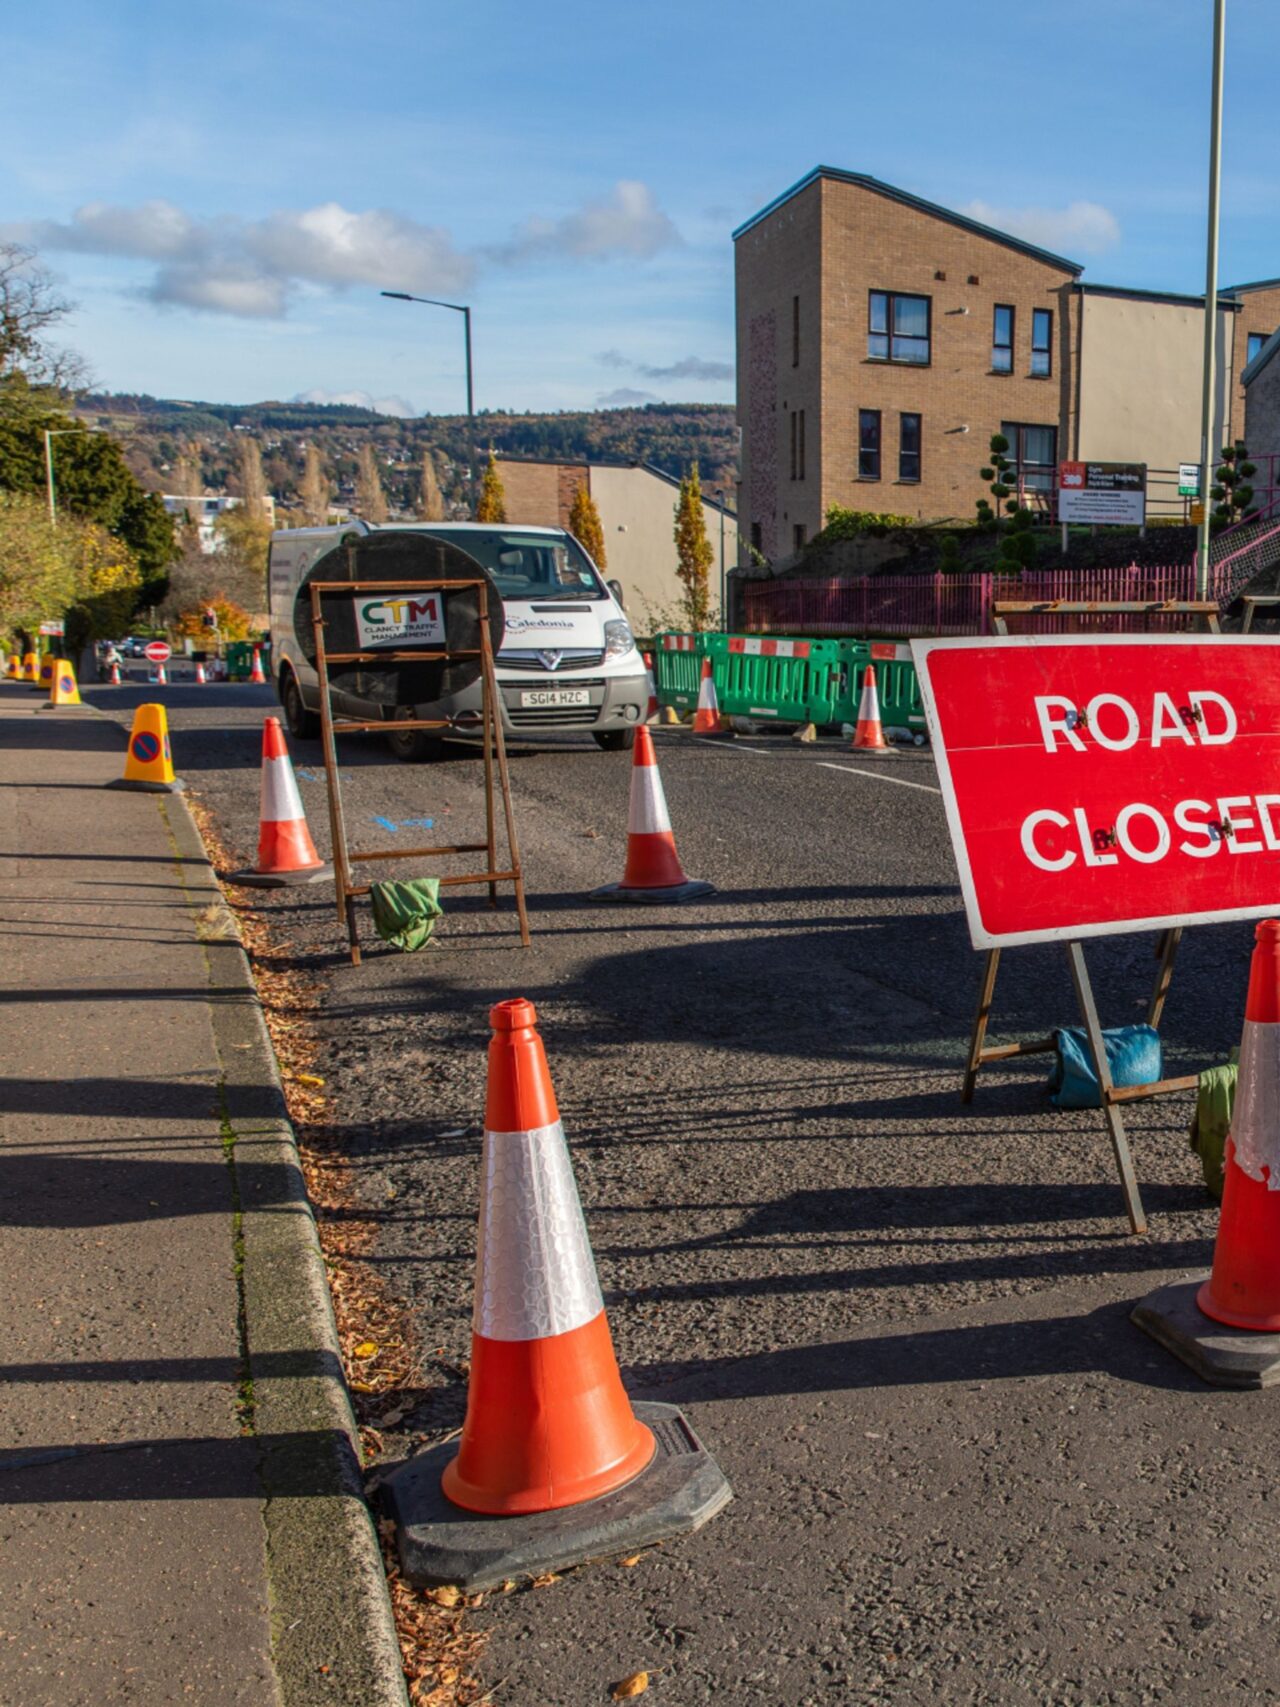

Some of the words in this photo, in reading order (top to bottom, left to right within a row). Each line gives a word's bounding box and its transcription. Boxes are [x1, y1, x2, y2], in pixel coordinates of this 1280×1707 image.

[1115, 473, 1139, 482] Training
[362, 598, 438, 625] CTM
[364, 625, 401, 634] CLANCY
[404, 622, 440, 631] TRAFFIC
[506, 617, 575, 629] Caledonia
[371, 630, 433, 641] MANAGEMENT
[529, 692, 557, 705] SG14
[559, 691, 583, 703] HZC
[1034, 690, 1238, 753] ROAD
